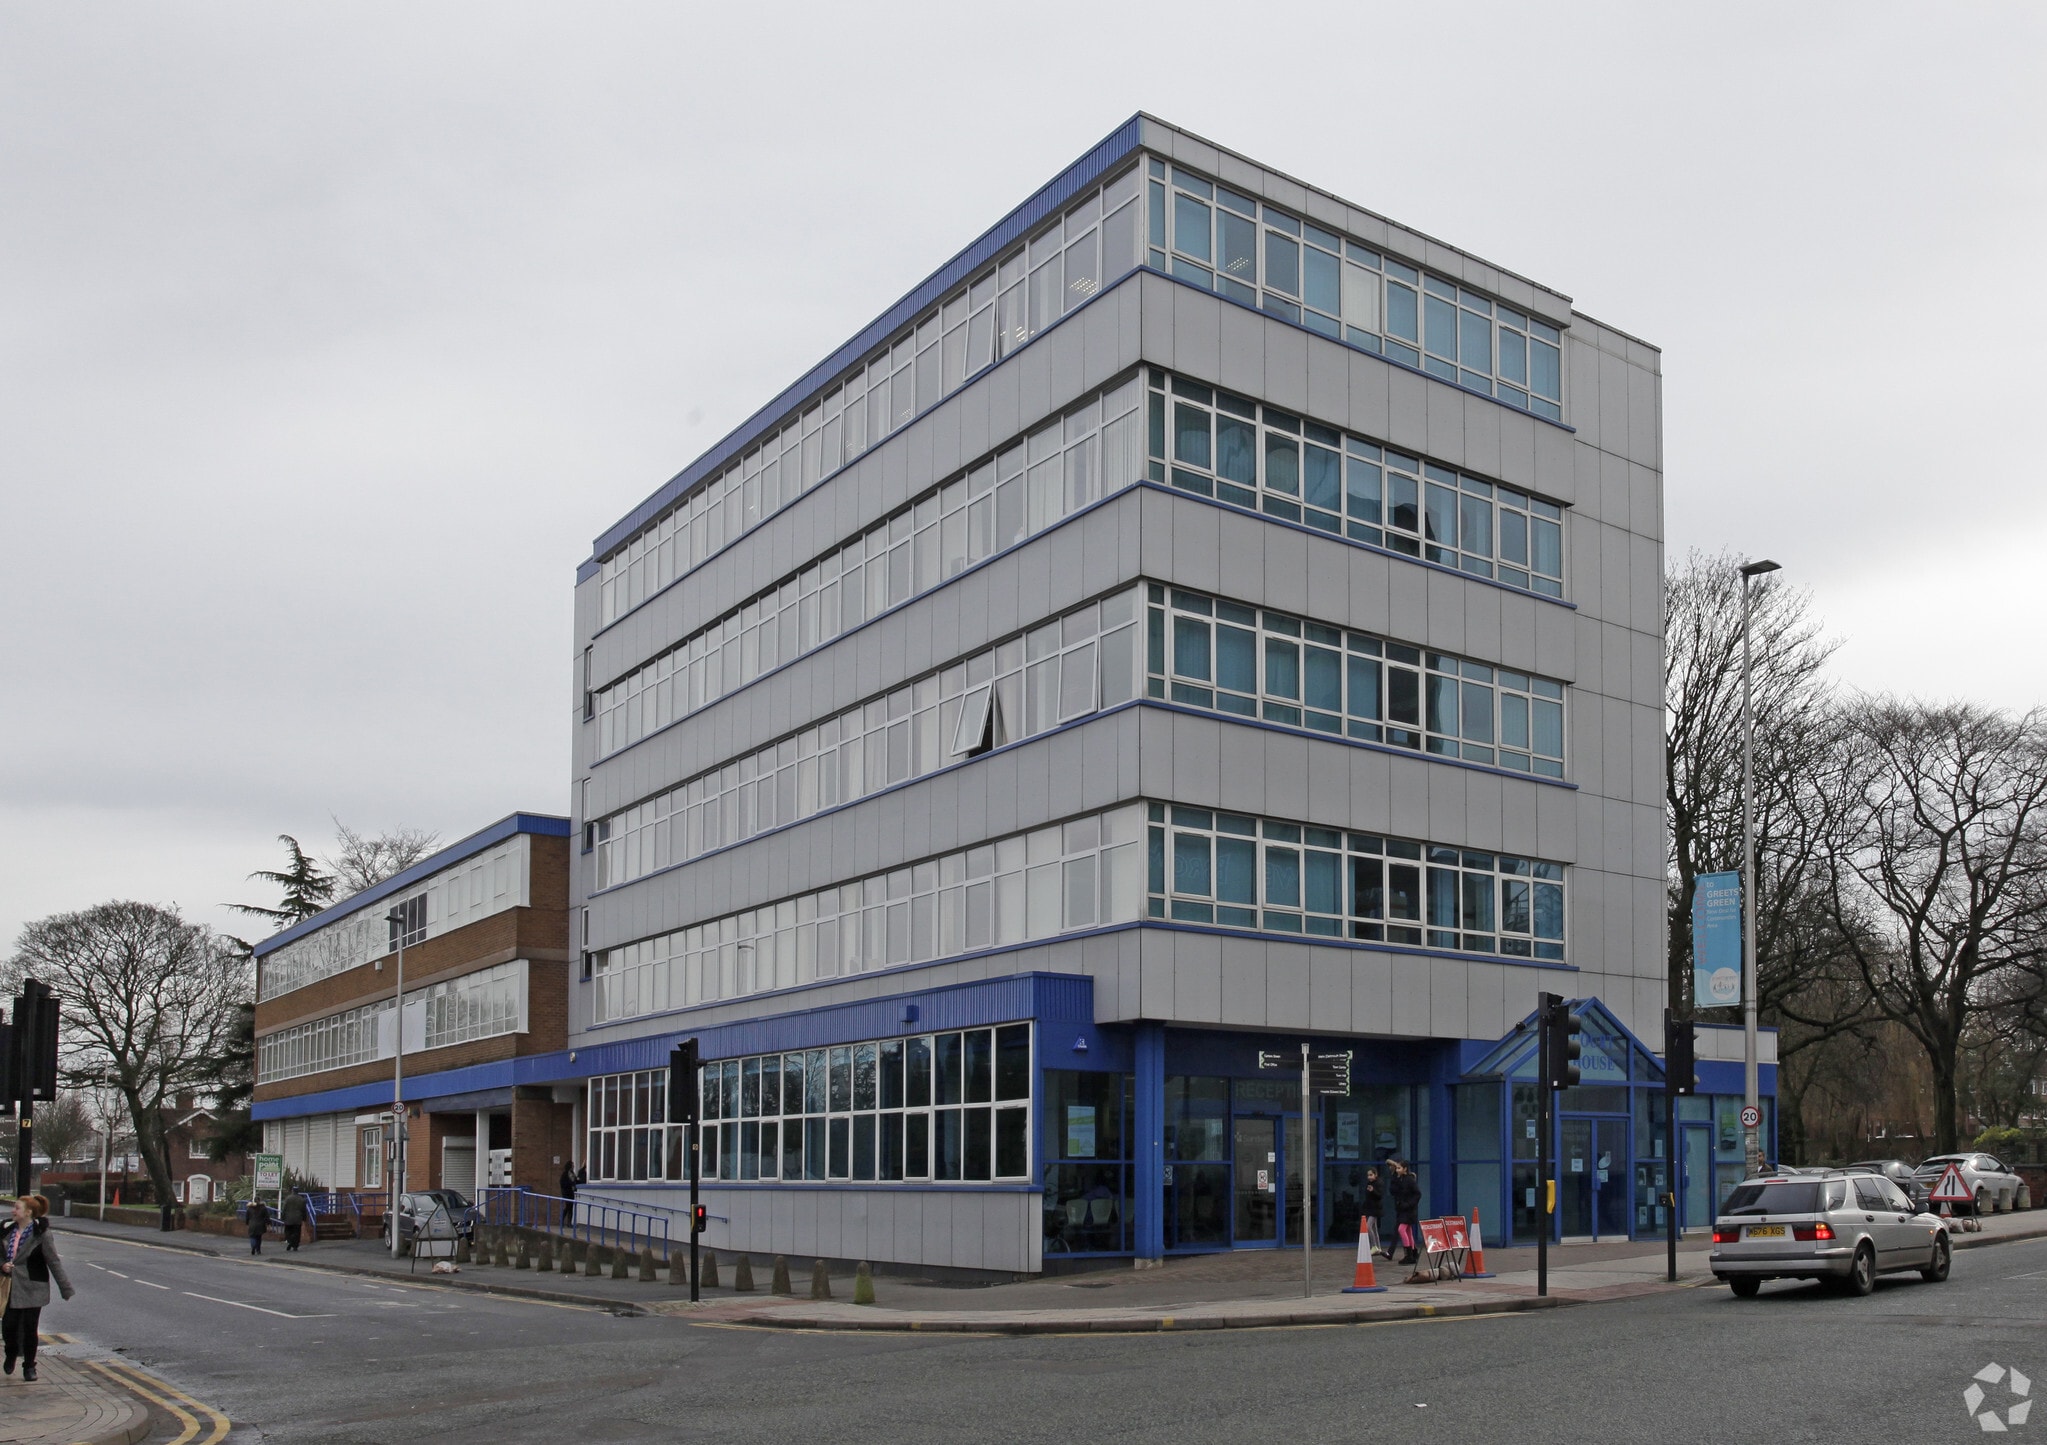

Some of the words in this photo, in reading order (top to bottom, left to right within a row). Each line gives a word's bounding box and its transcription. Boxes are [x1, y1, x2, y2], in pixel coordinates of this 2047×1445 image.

[1706, 888, 1739, 898] GREETS
[1706, 898, 1736, 907] GREEN
[1695, 882, 1707, 966] WELCOME
[1743, 1112, 1757, 1121] 20
[259, 1161, 280, 1171] point
